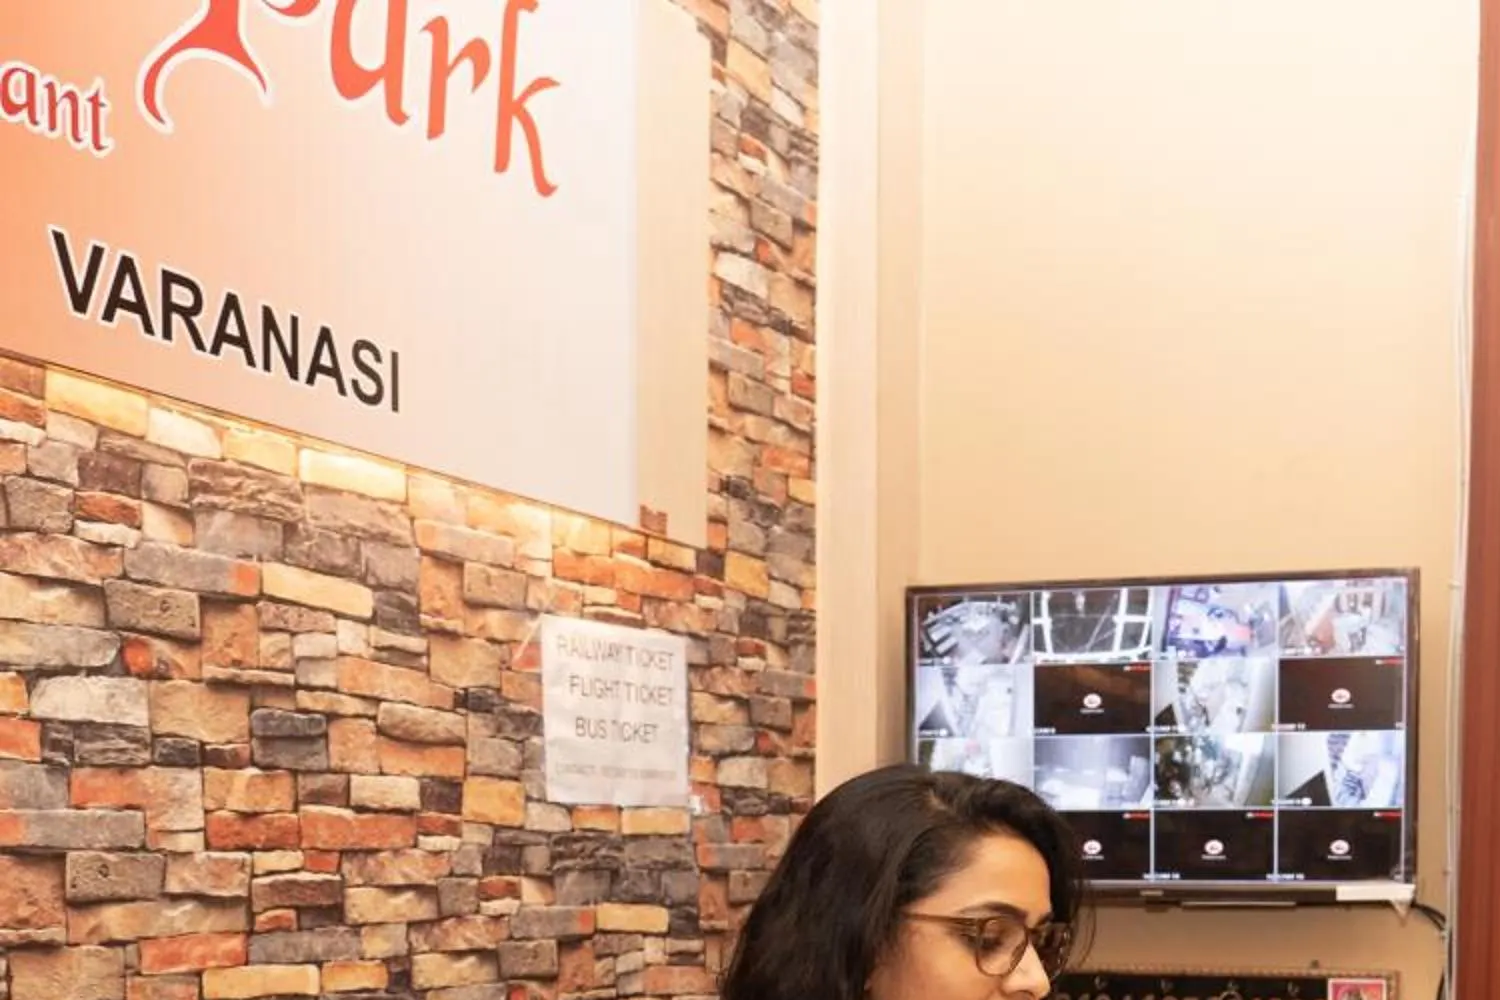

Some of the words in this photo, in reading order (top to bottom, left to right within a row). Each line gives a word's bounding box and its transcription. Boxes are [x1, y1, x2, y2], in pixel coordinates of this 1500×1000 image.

[51, 230, 399, 413] VARANASI
[625, 645, 674, 671] TICKET
[569, 674, 621, 698] FLIGHT
[623, 682, 673, 706] TICKET
[575, 716, 608, 739] BUS
